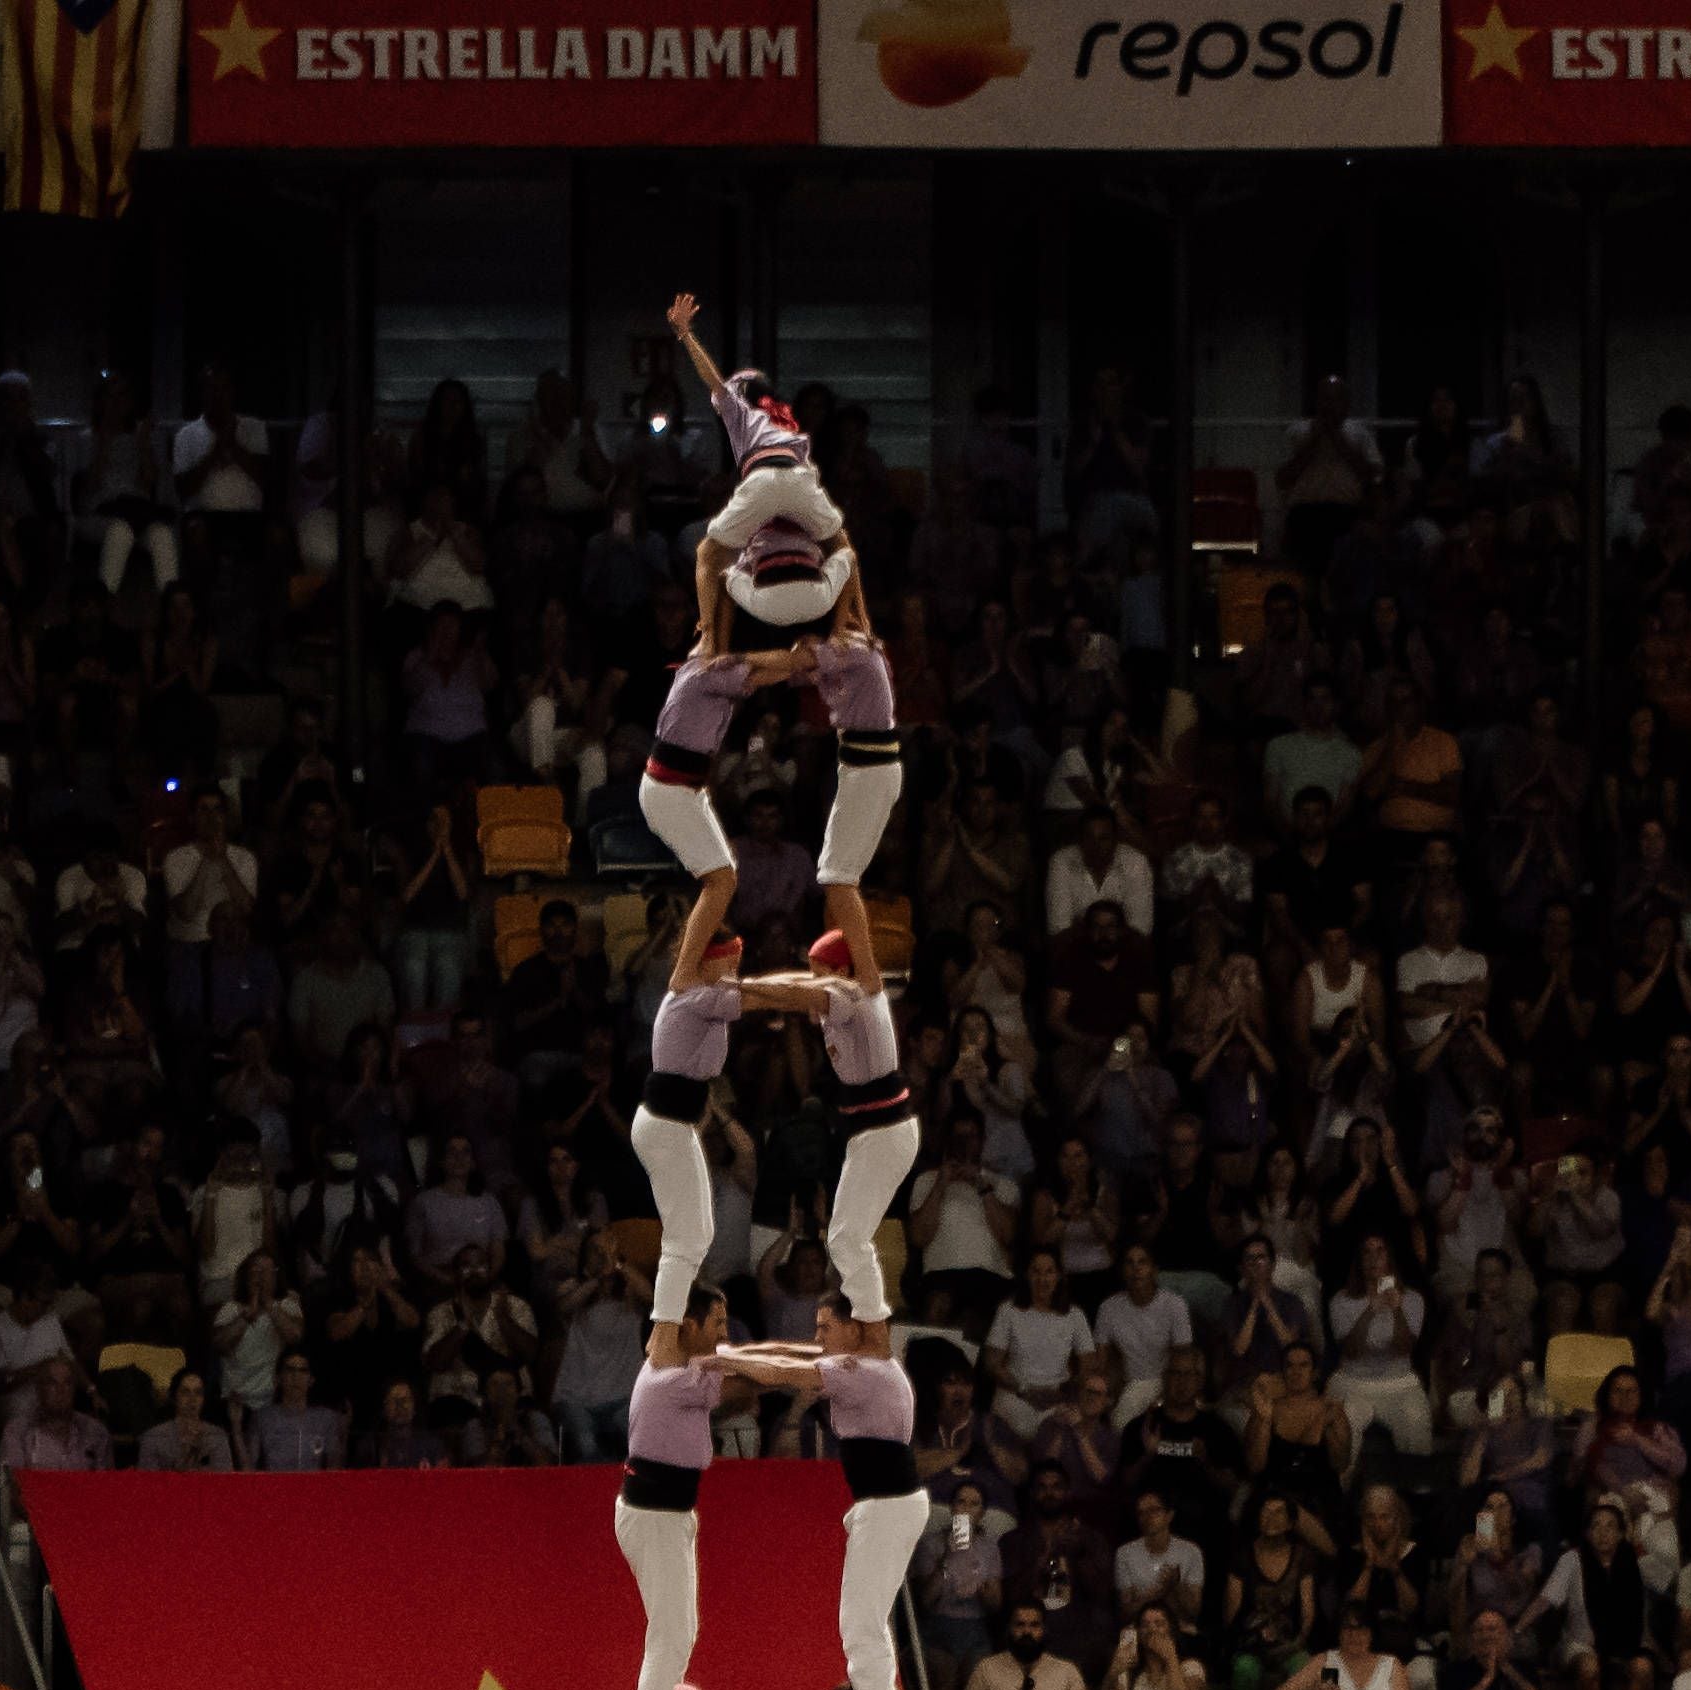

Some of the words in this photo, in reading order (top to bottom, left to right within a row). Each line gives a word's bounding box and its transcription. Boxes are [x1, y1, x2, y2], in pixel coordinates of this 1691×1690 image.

[296, 27, 591, 79] ESTRELLA
[606, 26, 798, 79] DAMM
[1074, 2, 1404, 97] repsol
